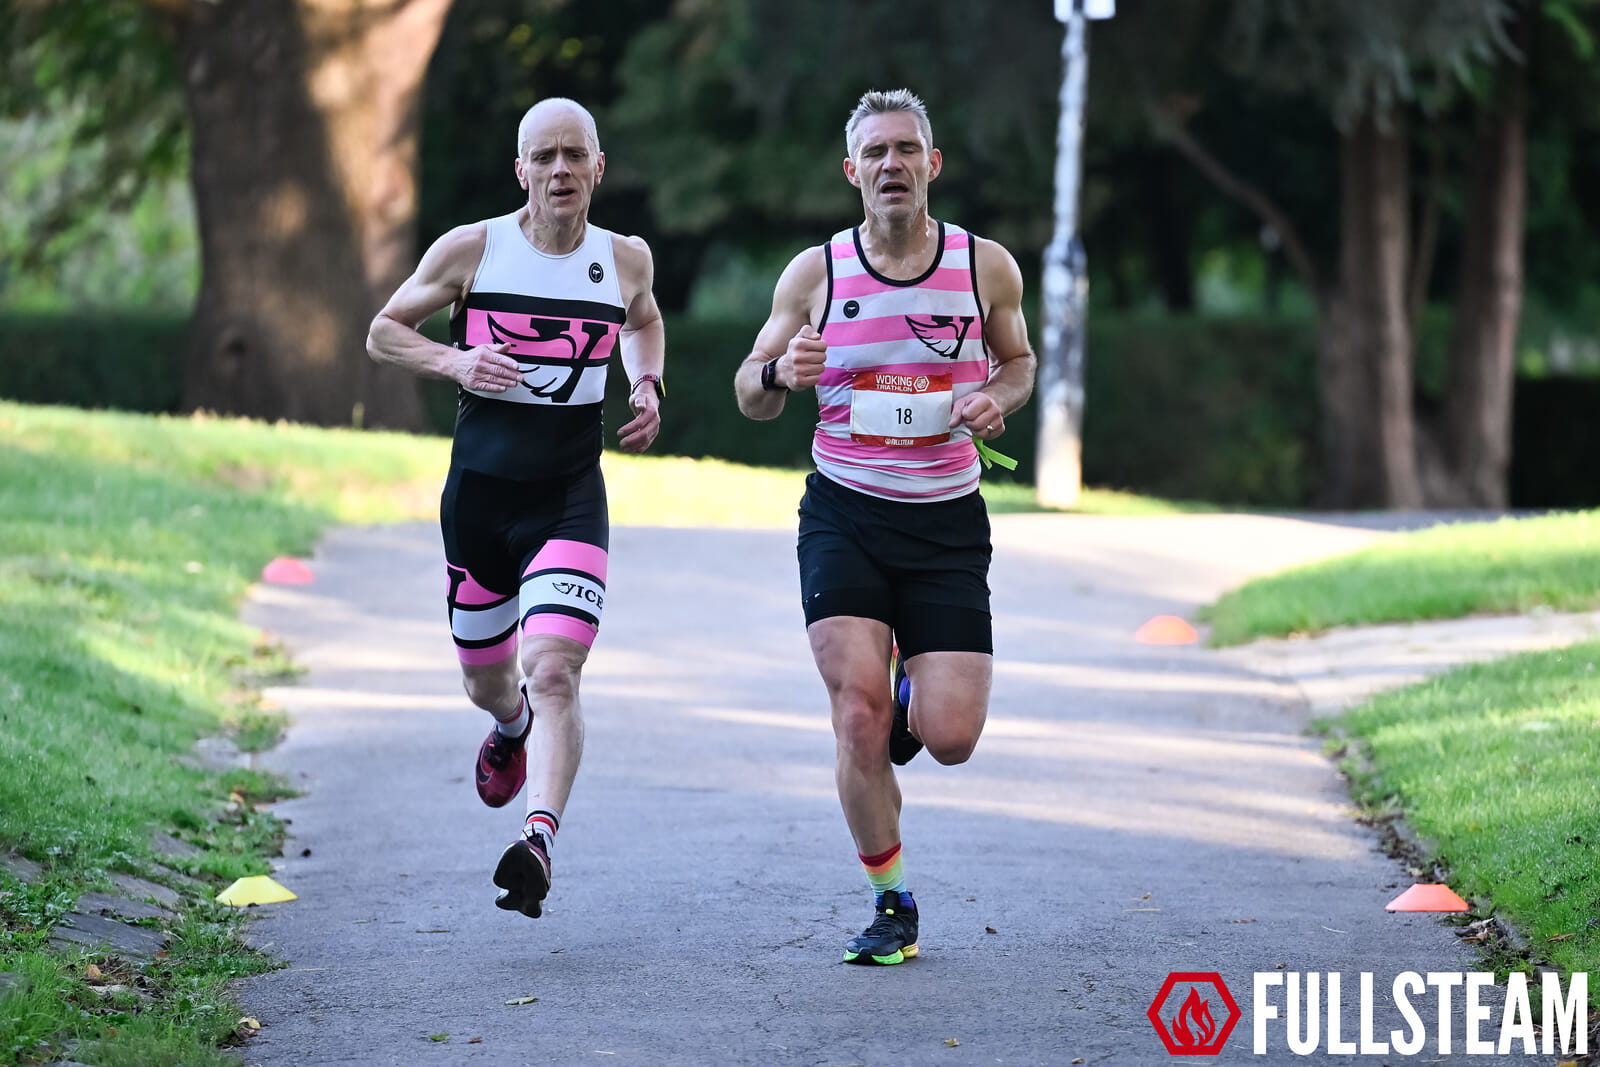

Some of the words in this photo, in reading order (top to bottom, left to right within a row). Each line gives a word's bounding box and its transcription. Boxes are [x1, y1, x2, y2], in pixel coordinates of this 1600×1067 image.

[875, 374, 912, 387] WOKING
[876, 384, 912, 392] TRIATHLON
[895, 407, 912, 424] 18
[552, 582, 603, 610] VICE
